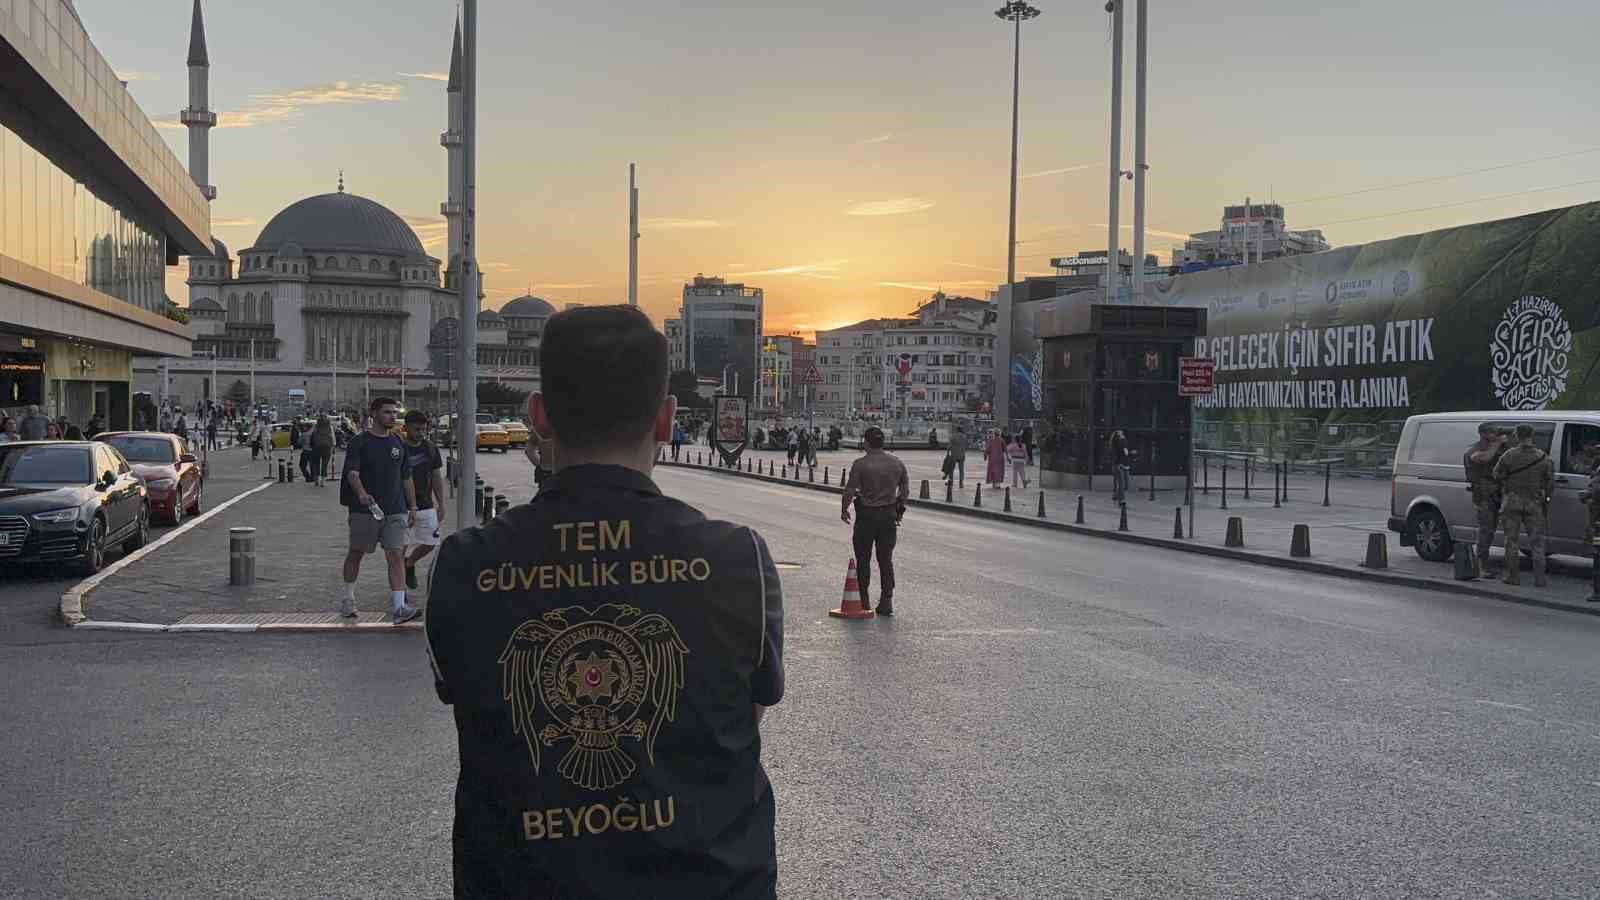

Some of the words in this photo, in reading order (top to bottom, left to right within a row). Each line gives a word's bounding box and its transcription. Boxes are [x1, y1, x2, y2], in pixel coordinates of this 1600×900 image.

[1211, 331, 1280, 372] GELECEK
[1284, 322, 1319, 375] İÇİN
[1324, 323, 1377, 368] SIFIR
[1382, 317, 1435, 363] ATIK
[1494, 319, 1565, 369] SIFIR
[1500, 347, 1568, 387] ATIK
[1229, 380, 1305, 409] HAYATIMIZIN
[1309, 379, 1337, 409] HER
[1340, 376, 1410, 408] ALANINA
[552, 519, 632, 553] TEM
[476, 556, 620, 592] GÜVENLİK
[630, 555, 712, 584] BÜRO
[521, 796, 676, 841] BEYOĞLU
